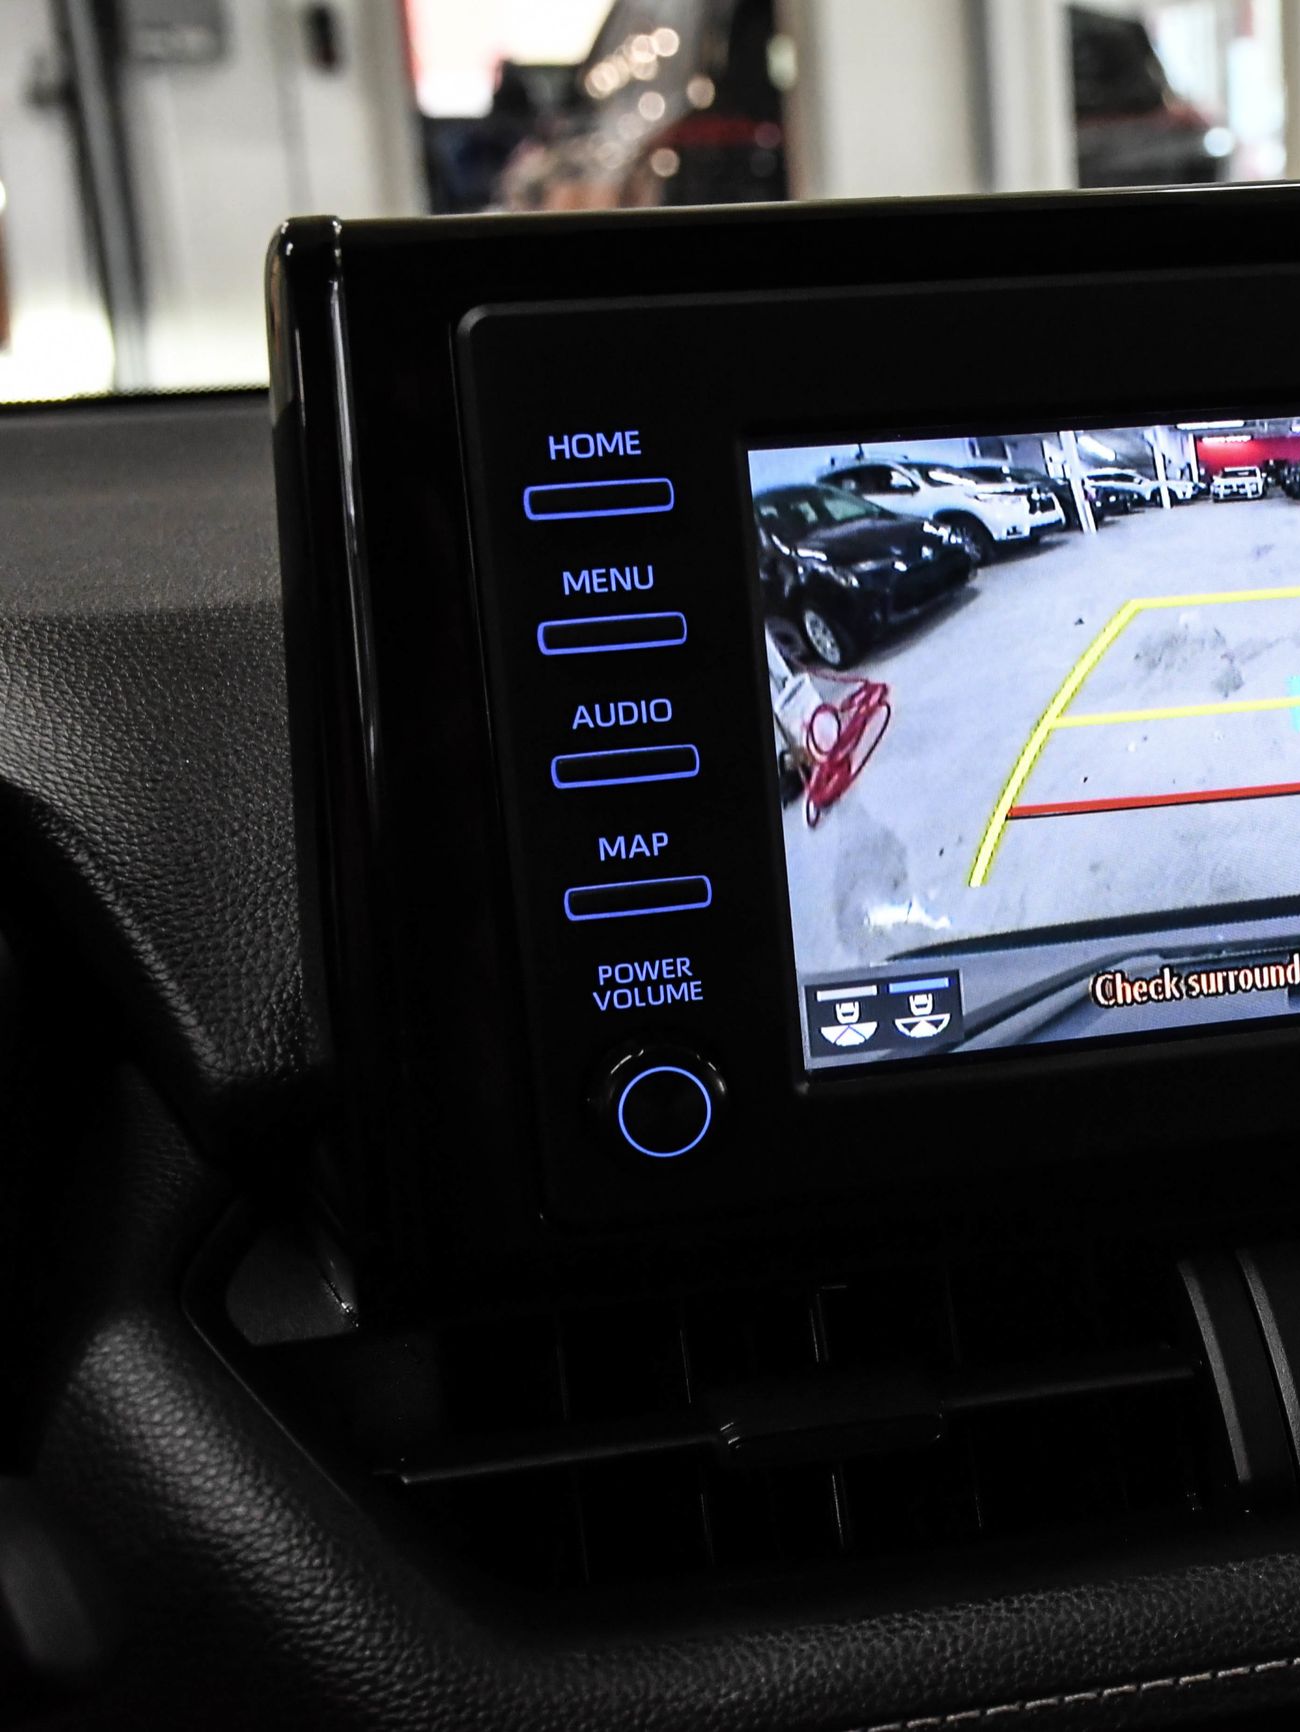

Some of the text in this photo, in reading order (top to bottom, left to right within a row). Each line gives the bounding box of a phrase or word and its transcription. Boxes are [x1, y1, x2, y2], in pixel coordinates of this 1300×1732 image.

[548, 430, 642, 461] HOME
[562, 564, 654, 596] MENU
[572, 698, 673, 730] AUDIO
[598, 831, 669, 862] MAP
[597, 957, 693, 986] POWER
[1094, 967, 1183, 1006] Check
[592, 980, 704, 1011] VOLUME
